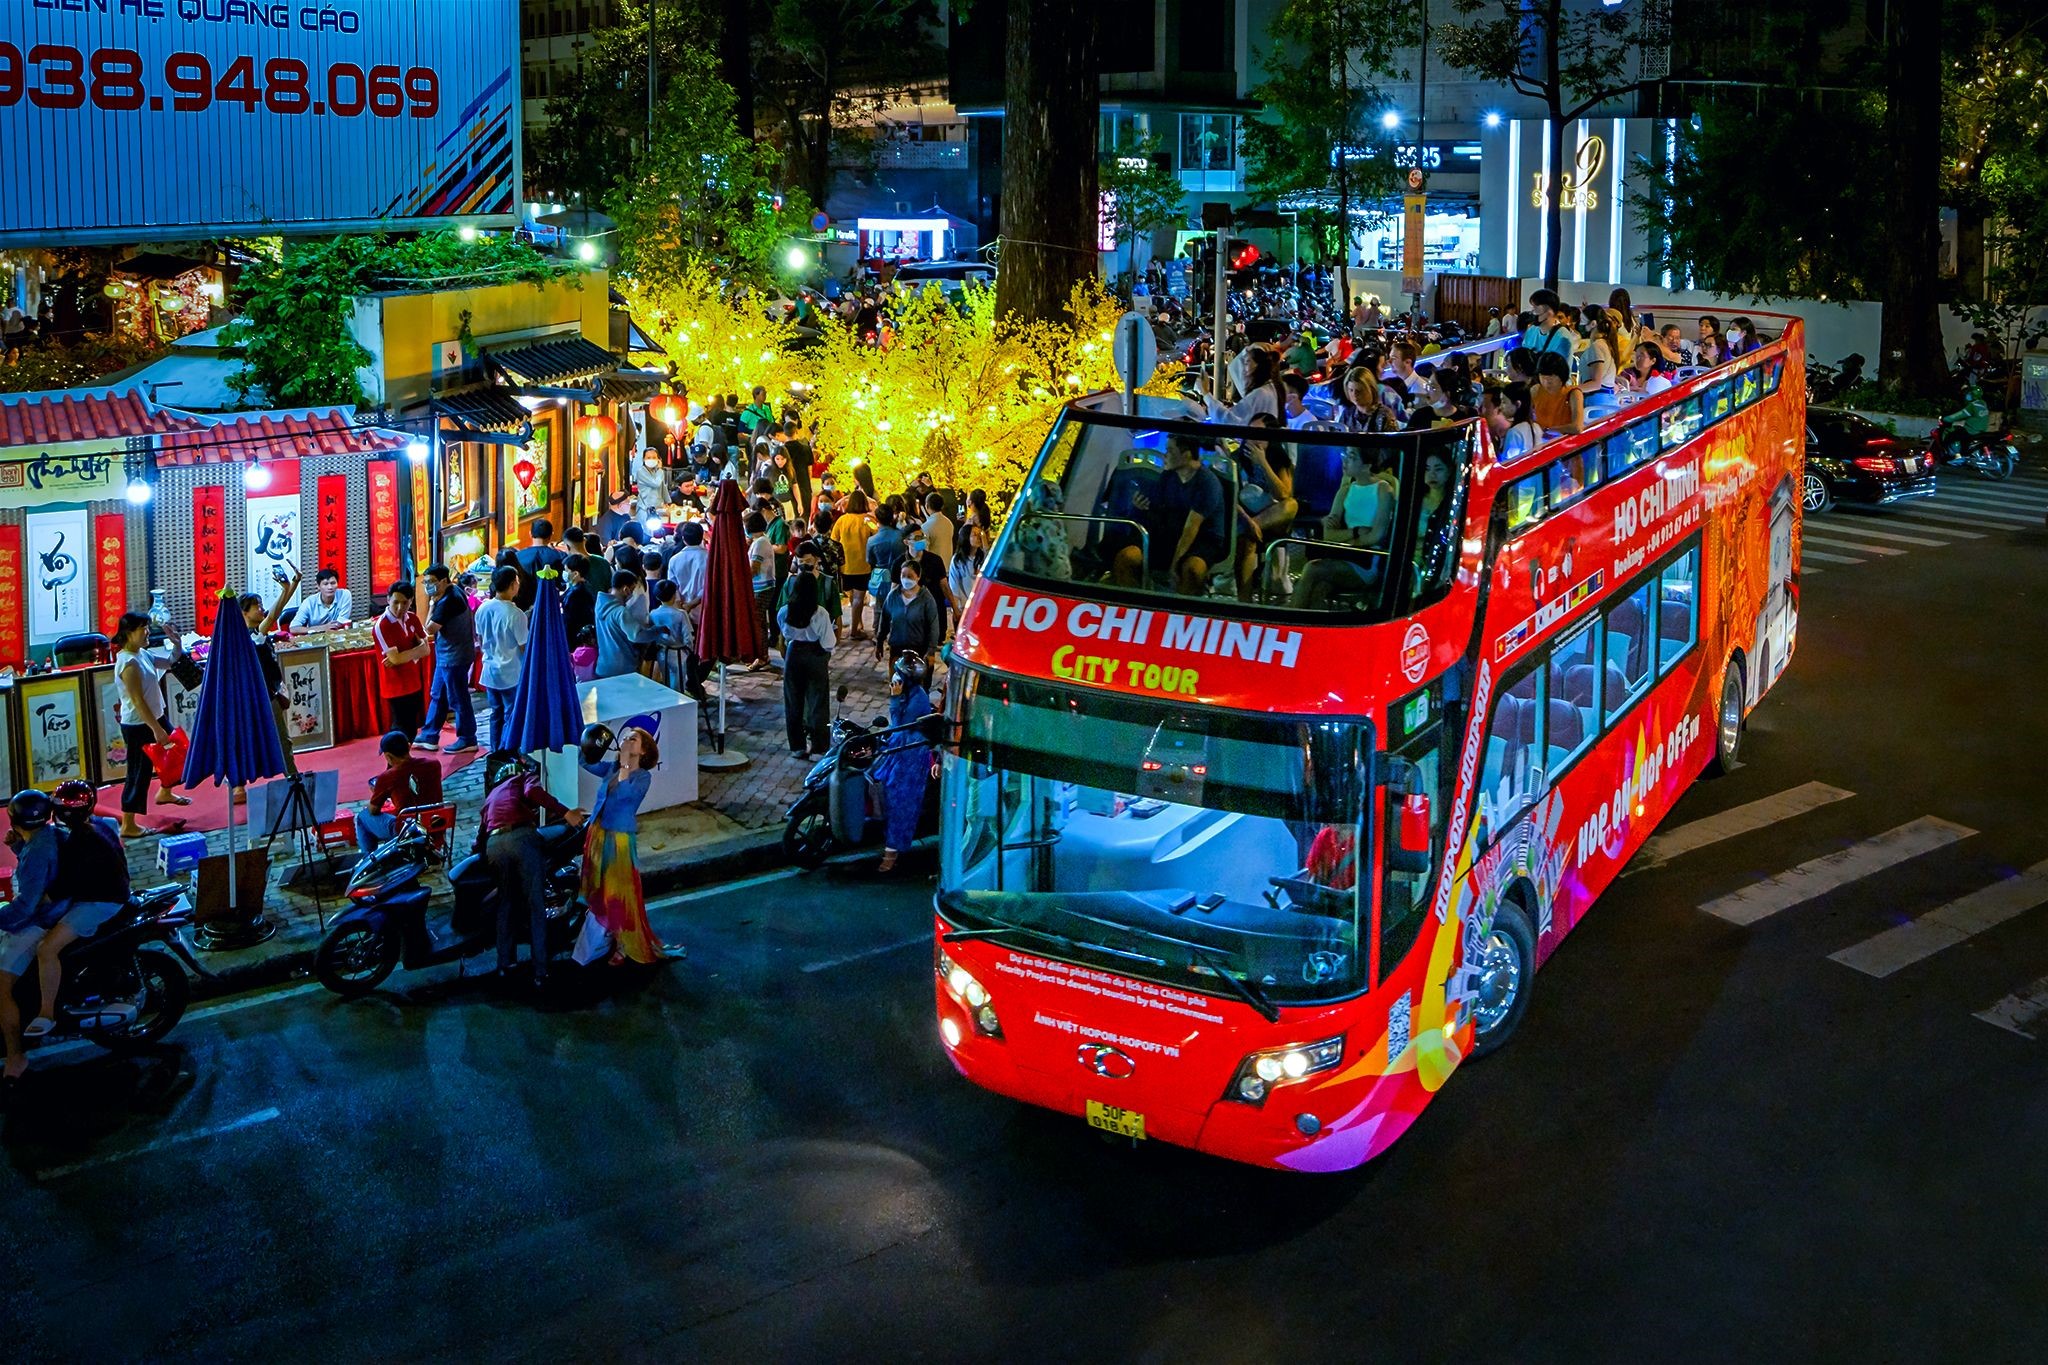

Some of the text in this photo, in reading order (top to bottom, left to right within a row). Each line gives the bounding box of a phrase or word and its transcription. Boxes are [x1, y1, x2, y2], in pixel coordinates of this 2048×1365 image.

[299, 3, 360, 34] CÁO
[1531, 189, 1598, 209] SLARS
[1614, 496, 1638, 546] HO
[1640, 479, 1664, 528] CHI
[1666, 457, 1699, 511] MINH
[990, 595, 1303, 668] HO CHI MINH
[1127, 661, 1199, 694] TOUR
[1577, 802, 1608, 869] HOP
[996, 962, 1223, 1024] Priority Project to develop tourism by the Government
[1112, 978, 1125, 987] du
[1160, 989, 1187, 1002] Chính
[1163, 1045, 1179, 1057] VN
[1102, 1103, 1127, 1120] 50F
